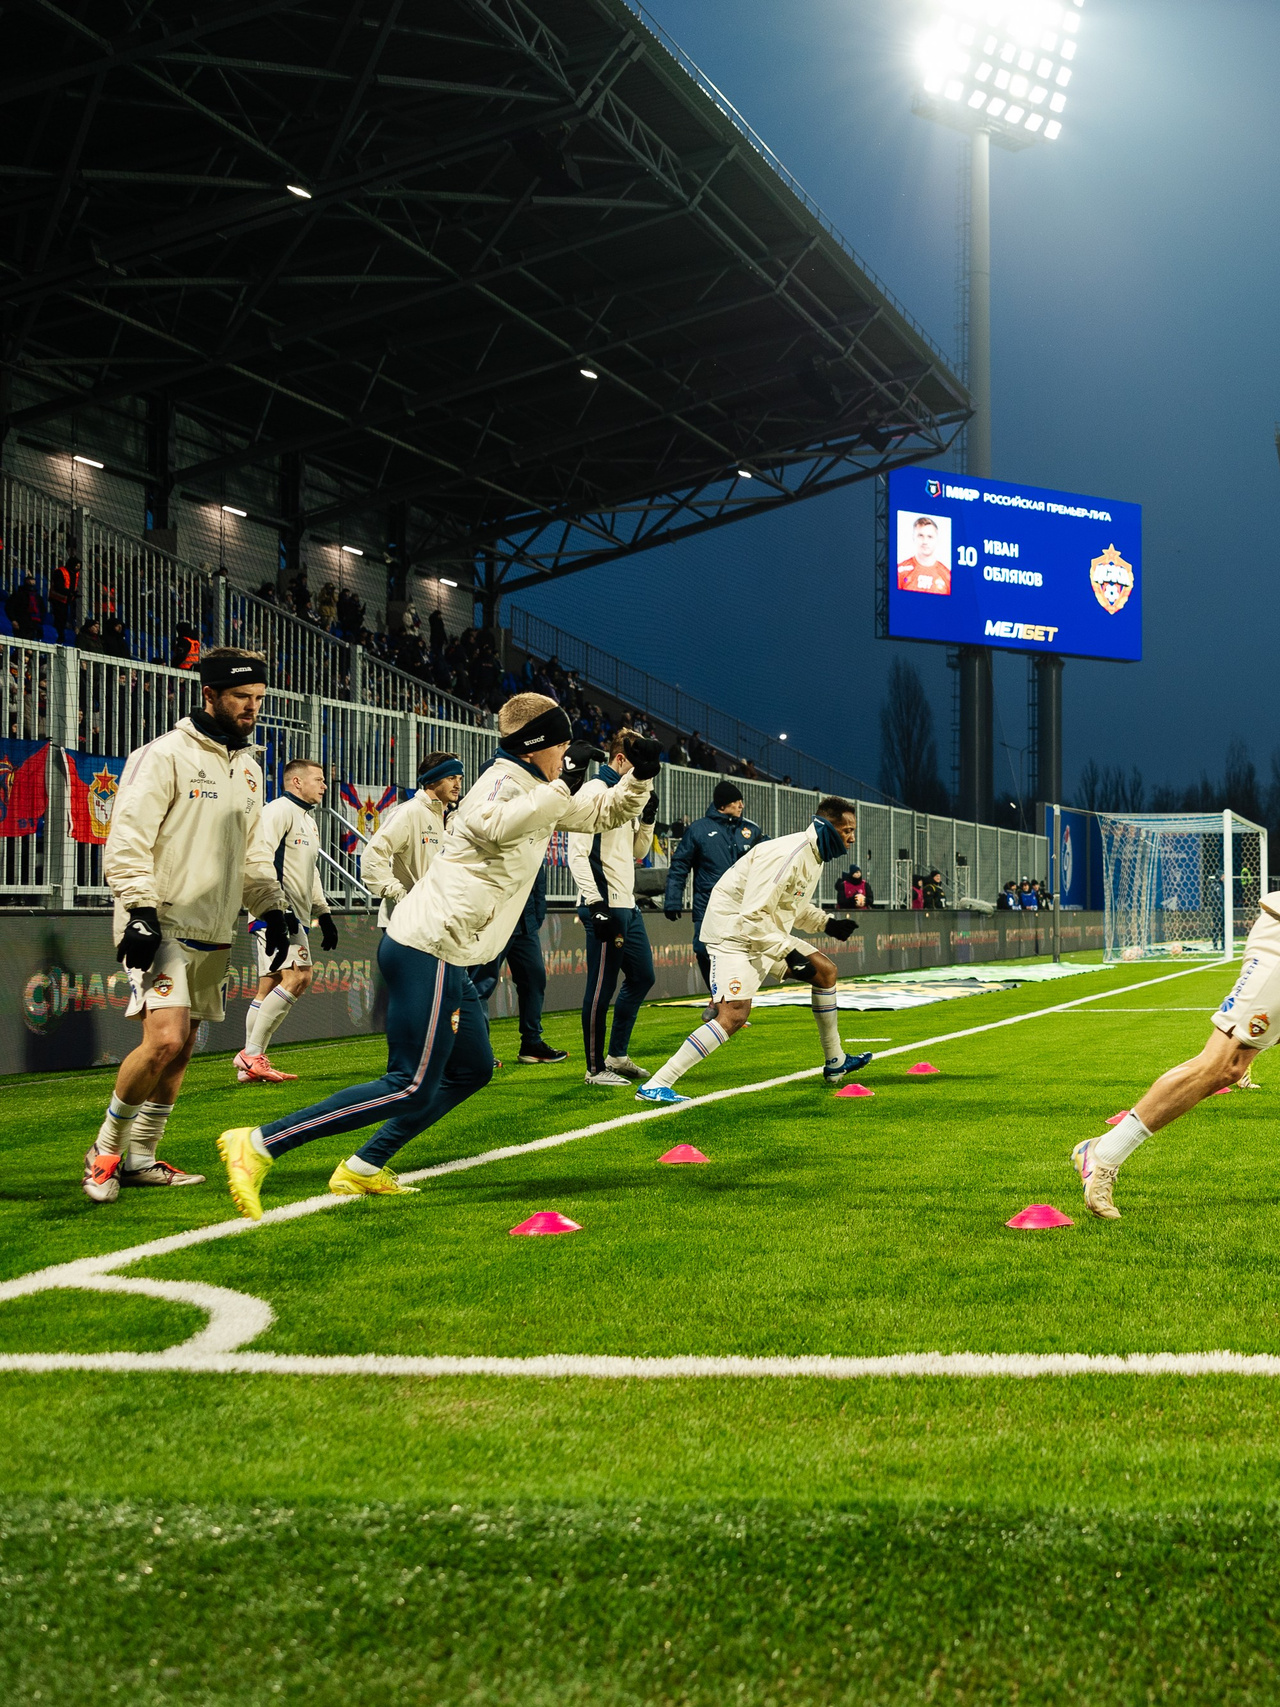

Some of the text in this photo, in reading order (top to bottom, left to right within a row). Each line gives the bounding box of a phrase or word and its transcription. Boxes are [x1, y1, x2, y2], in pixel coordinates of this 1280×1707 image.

[945, 484, 1112, 522] МИР РОССИЙСКАЯ ПРЕМЬЕР-ЛИГА
[957, 545, 978, 567] 10
[983, 539, 1019, 558] ИВАН
[983, 566, 1043, 587] ОБЛЯКОВ
[984, 619, 1059, 643] МЕЛБЕТ
